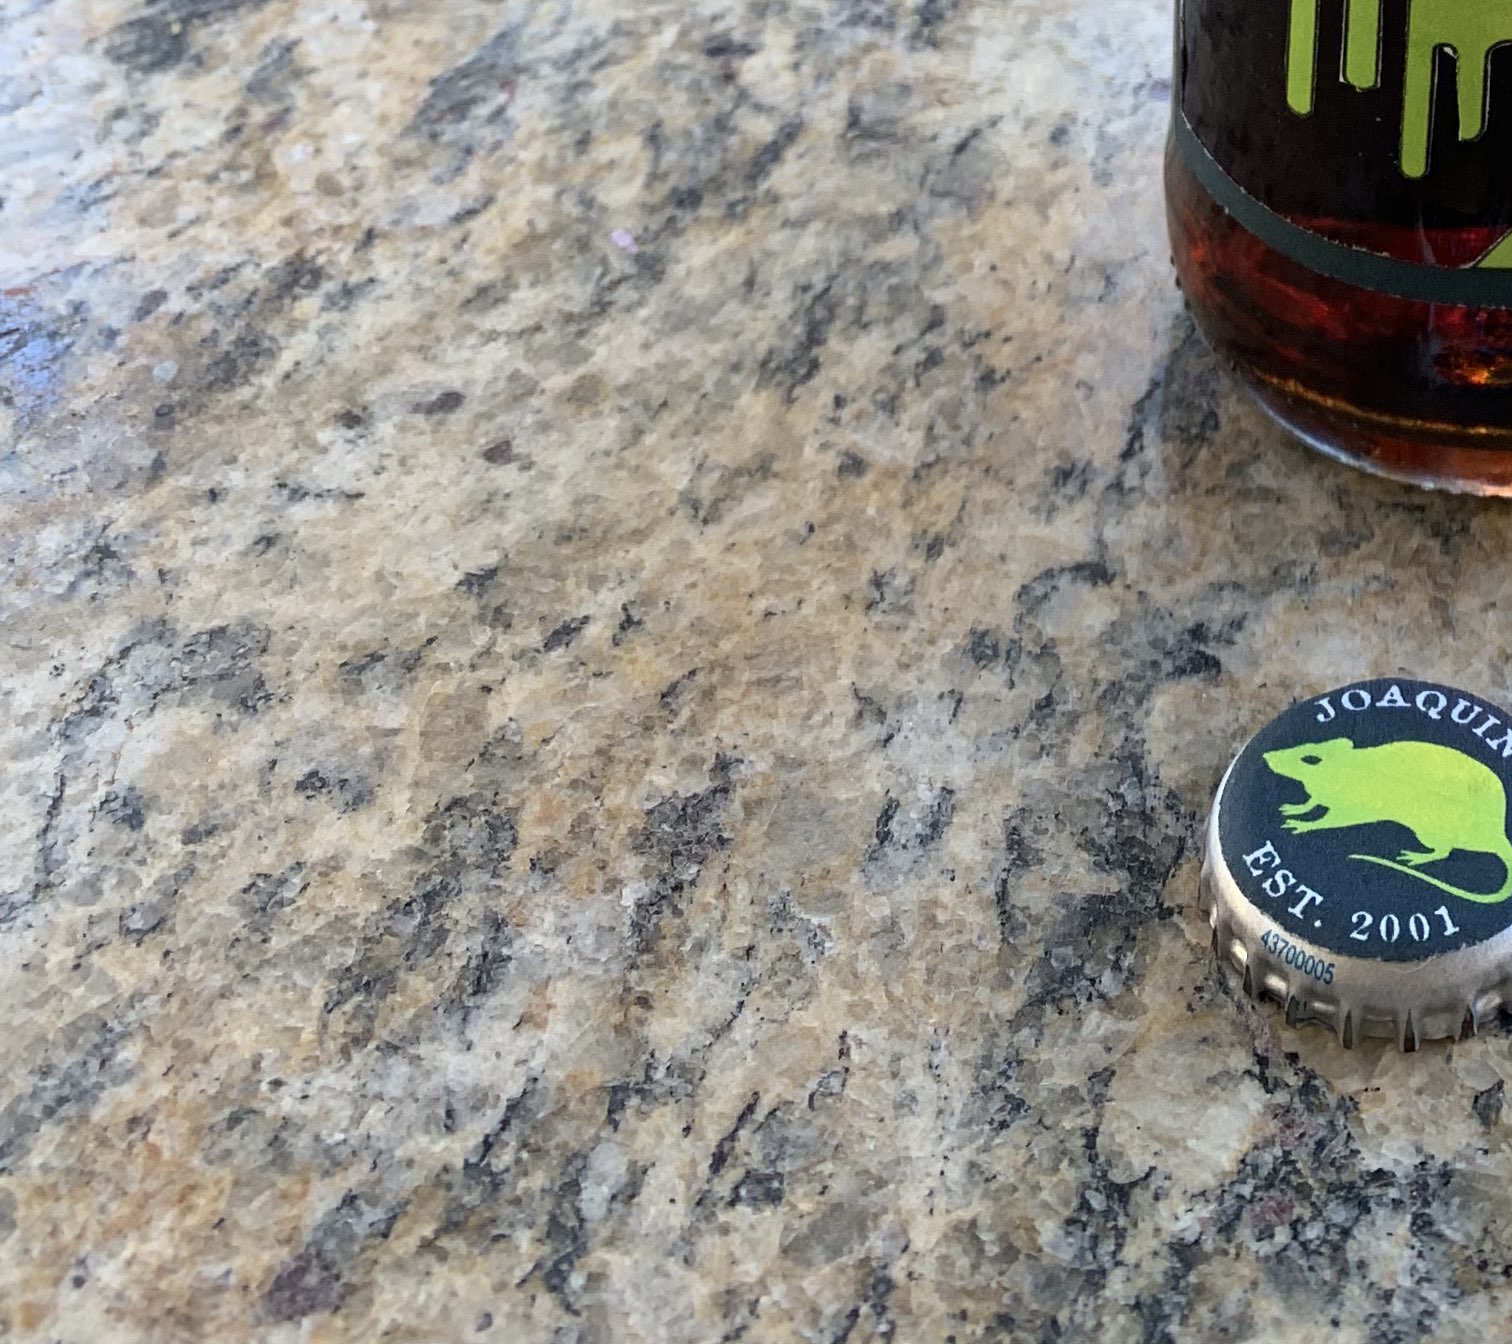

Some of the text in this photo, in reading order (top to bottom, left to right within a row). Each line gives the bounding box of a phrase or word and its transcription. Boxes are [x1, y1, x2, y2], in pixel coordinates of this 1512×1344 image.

[1243, 840, 1460, 943] EST. 2001
[1260, 929, 1335, 986] 43700005
